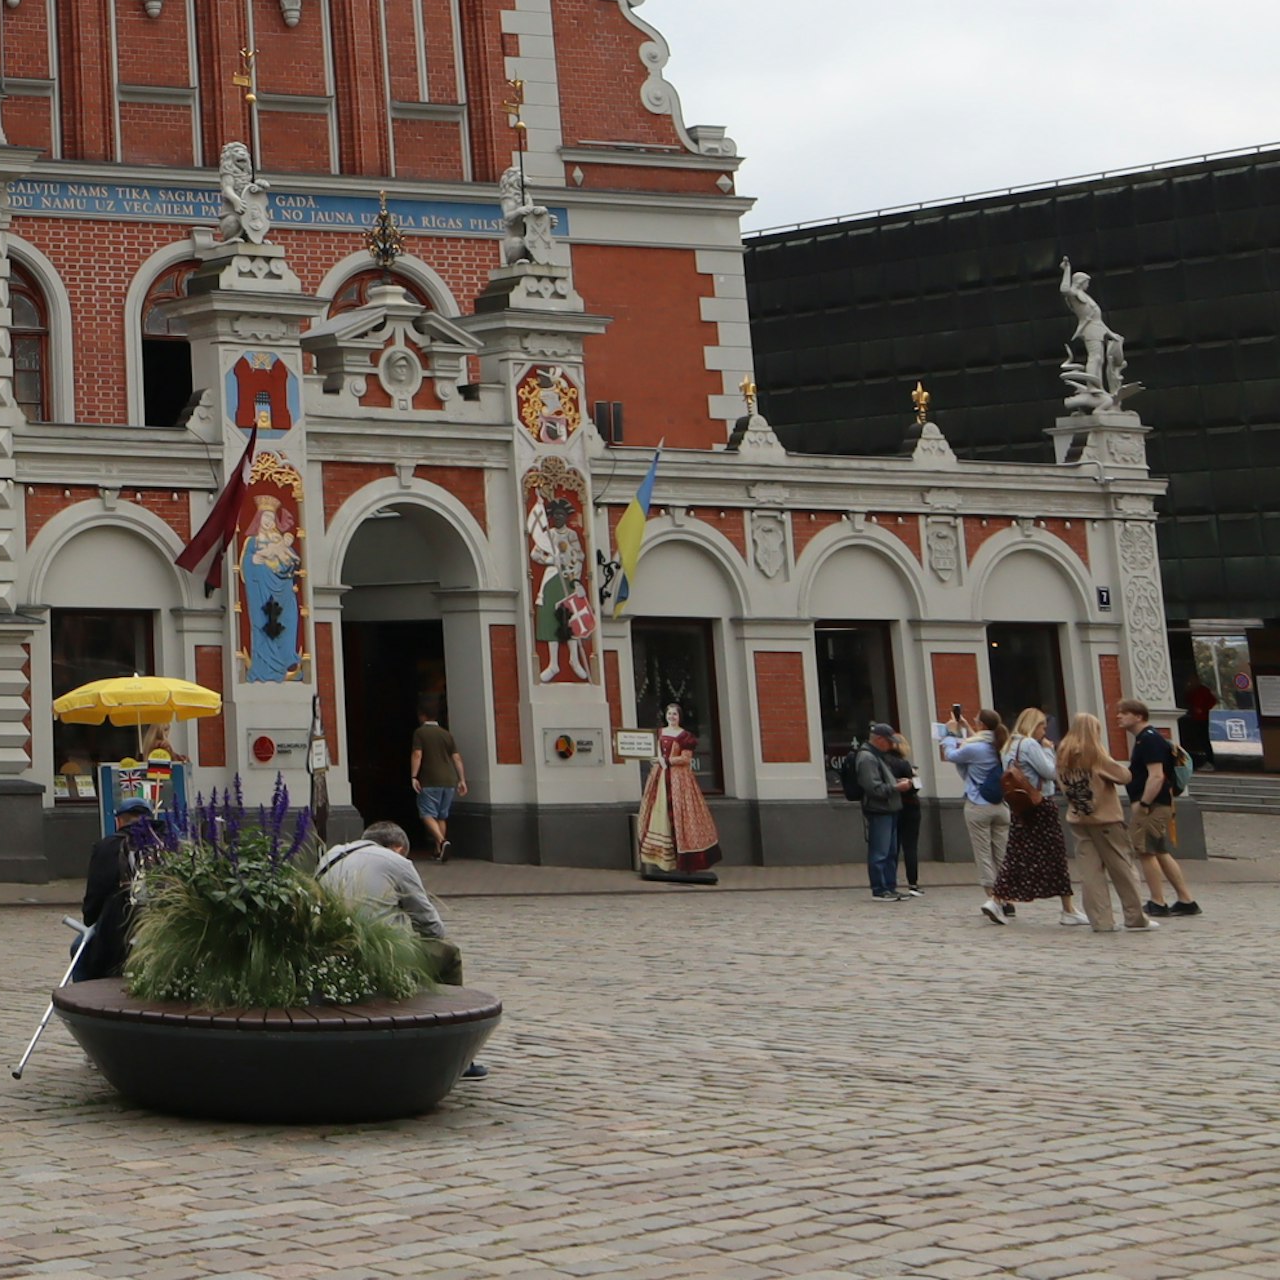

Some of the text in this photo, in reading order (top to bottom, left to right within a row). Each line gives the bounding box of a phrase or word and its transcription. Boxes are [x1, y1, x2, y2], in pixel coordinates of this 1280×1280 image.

[67, 184, 108, 198] NAMS
[115, 187, 151, 200] TIKA
[41, 197, 87, 210] NAMU
[96, 199, 116, 211] UZ
[123, 201, 194, 216] VECAJIEM
[281, 209, 303, 221] NO
[311, 211, 355, 224] JAUNA
